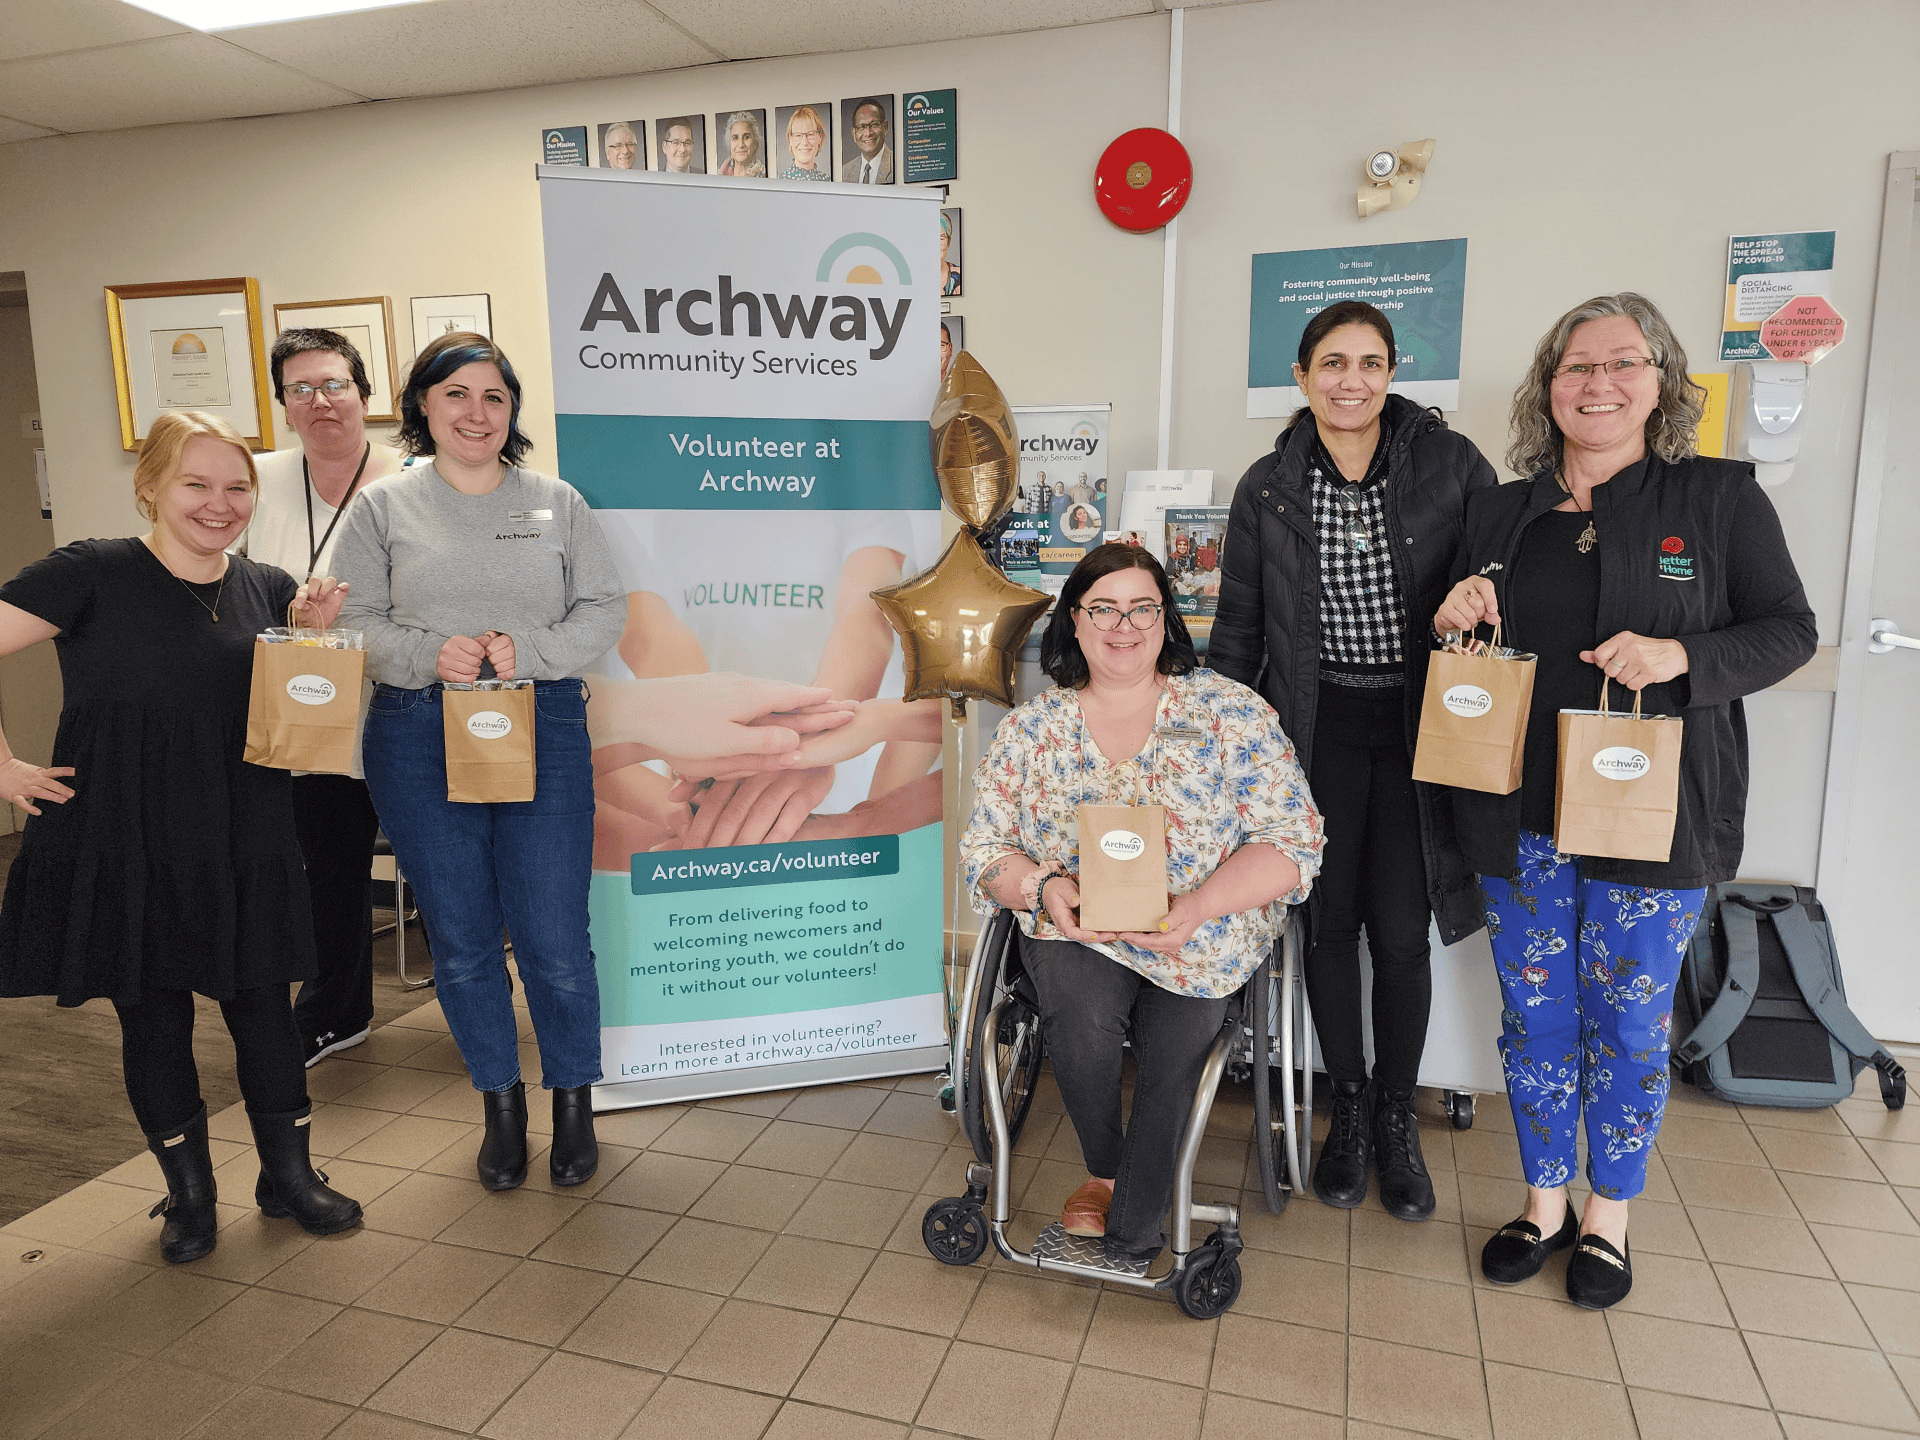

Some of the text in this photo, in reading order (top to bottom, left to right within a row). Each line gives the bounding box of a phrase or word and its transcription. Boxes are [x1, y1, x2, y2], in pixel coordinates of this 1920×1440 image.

[907, 109, 920, 117] Our
[1734, 240, 1779, 250] HELP STOP
[1732, 247, 1784, 257] THE SPREAD
[1340, 260, 1373, 270] Our Mission
[1744, 255, 1784, 264] COVID-19
[1283, 272, 1431, 290] Fostering community well-being
[1278, 286, 1434, 302] and social justice through positive
[1741, 284, 1793, 294] DISTANCING
[1306, 300, 1404, 314] acti dership
[579, 272, 913, 361] Archway
[1768, 318, 1842, 326] RECOMMENDED
[1791, 328, 1836, 336] CHILDREN
[1724, 347, 1760, 356] Archway
[1782, 350, 1811, 358] OF AG
[578, 344, 858, 380] Community Services
[1402, 354, 1414, 364] all
[668, 433, 841, 459] Volunteer at
[1020, 434, 1099, 456] rchway
[1020, 453, 1083, 464] munity Services
[698, 469, 817, 499] Archway
[1206, 512, 1229, 520] Volunte
[1037, 519, 1050, 529] at
[494, 532, 542, 540] Archway
[1038, 551, 1082, 560] .ca/careers
[1663, 564, 1694, 576] Home
[683, 582, 824, 610] VOLUNTEER
[1176, 602, 1197, 611] chway
[290, 684, 332, 697] Archway
[1446, 694, 1488, 710] Archway
[471, 721, 508, 731] Archway
[1598, 758, 1646, 771] Archway
[1104, 840, 1142, 852] Archway
[651, 850, 881, 881] Archway.ca/volunteer
[669, 900, 869, 927] From delivering food to
[653, 918, 882, 951] welcoming newcomers and
[630, 938, 905, 977] mentoring youth, we couldn't do
[662, 962, 877, 997] it without our volunteers!
[659, 1019, 882, 1057] Interested in volunteering?
[621, 1033, 918, 1076] Learn more at archway.ca/volunteer
